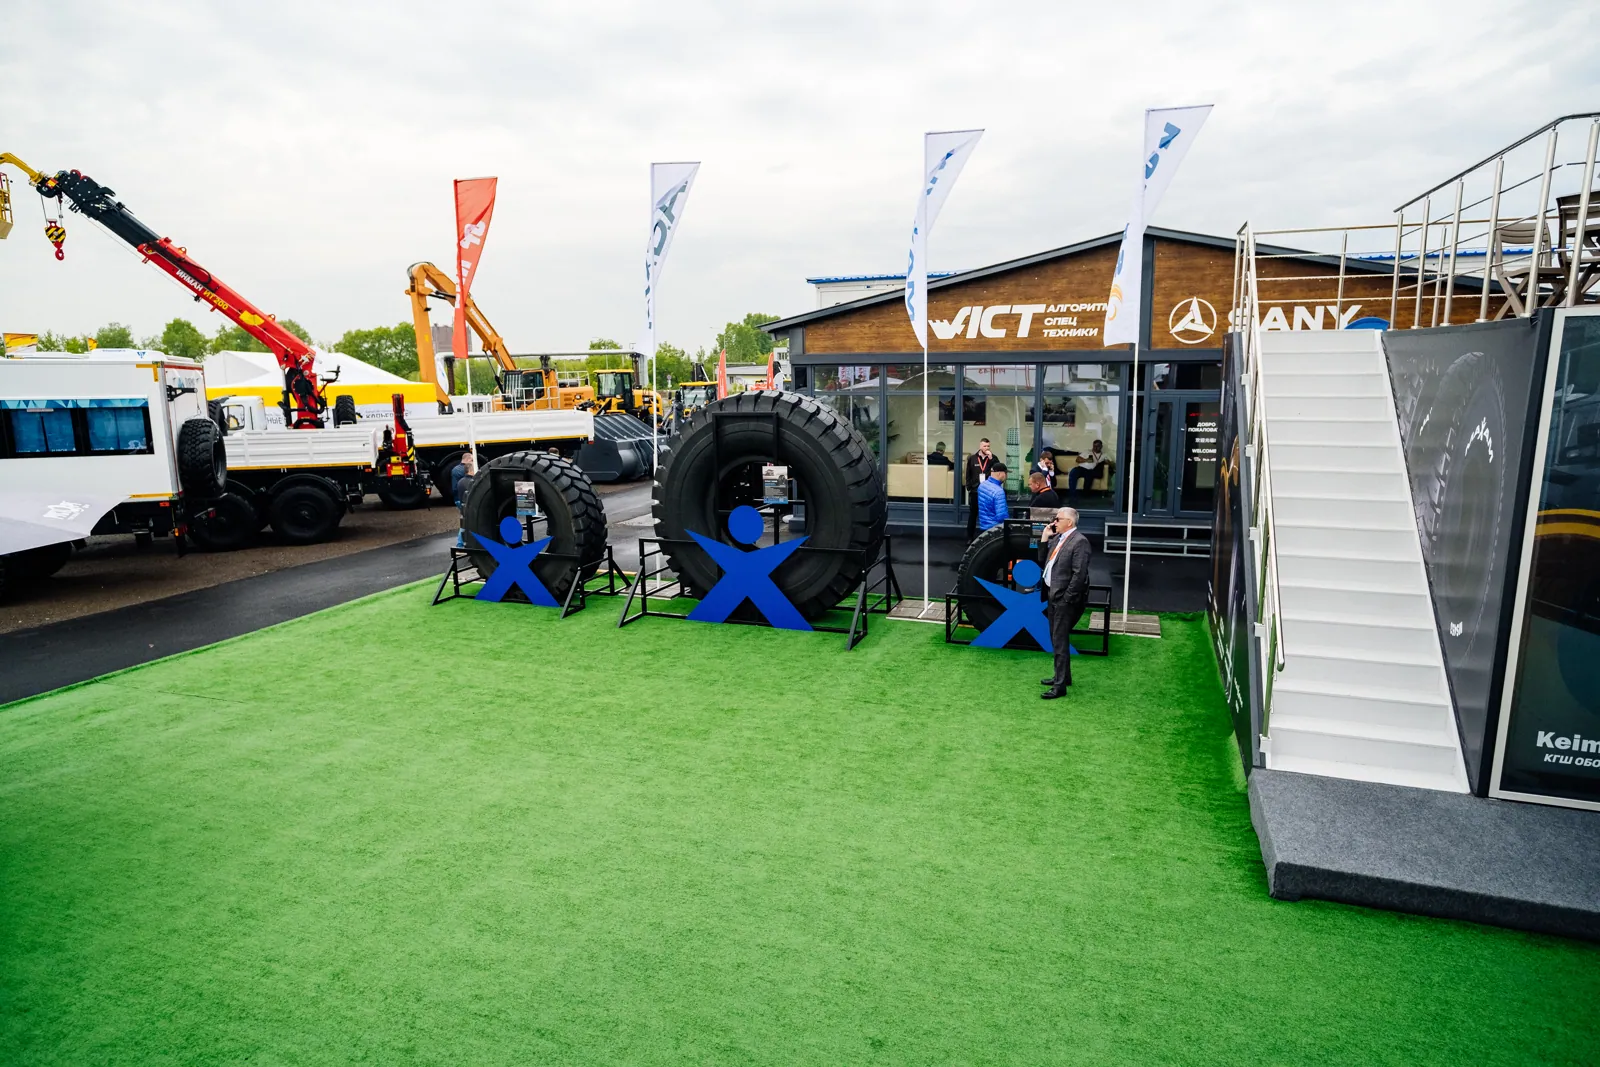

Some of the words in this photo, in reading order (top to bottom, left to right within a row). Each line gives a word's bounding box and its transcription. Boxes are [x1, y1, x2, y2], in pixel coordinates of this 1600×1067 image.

[176, 269, 203, 291] ИНМАН
[213, 298, 228, 310] 200
[1044, 317, 1077, 326] СПЕЦ
[1042, 328, 1099, 338] ТЕХНИКИ
[1543, 753, 1574, 765] КГШ
